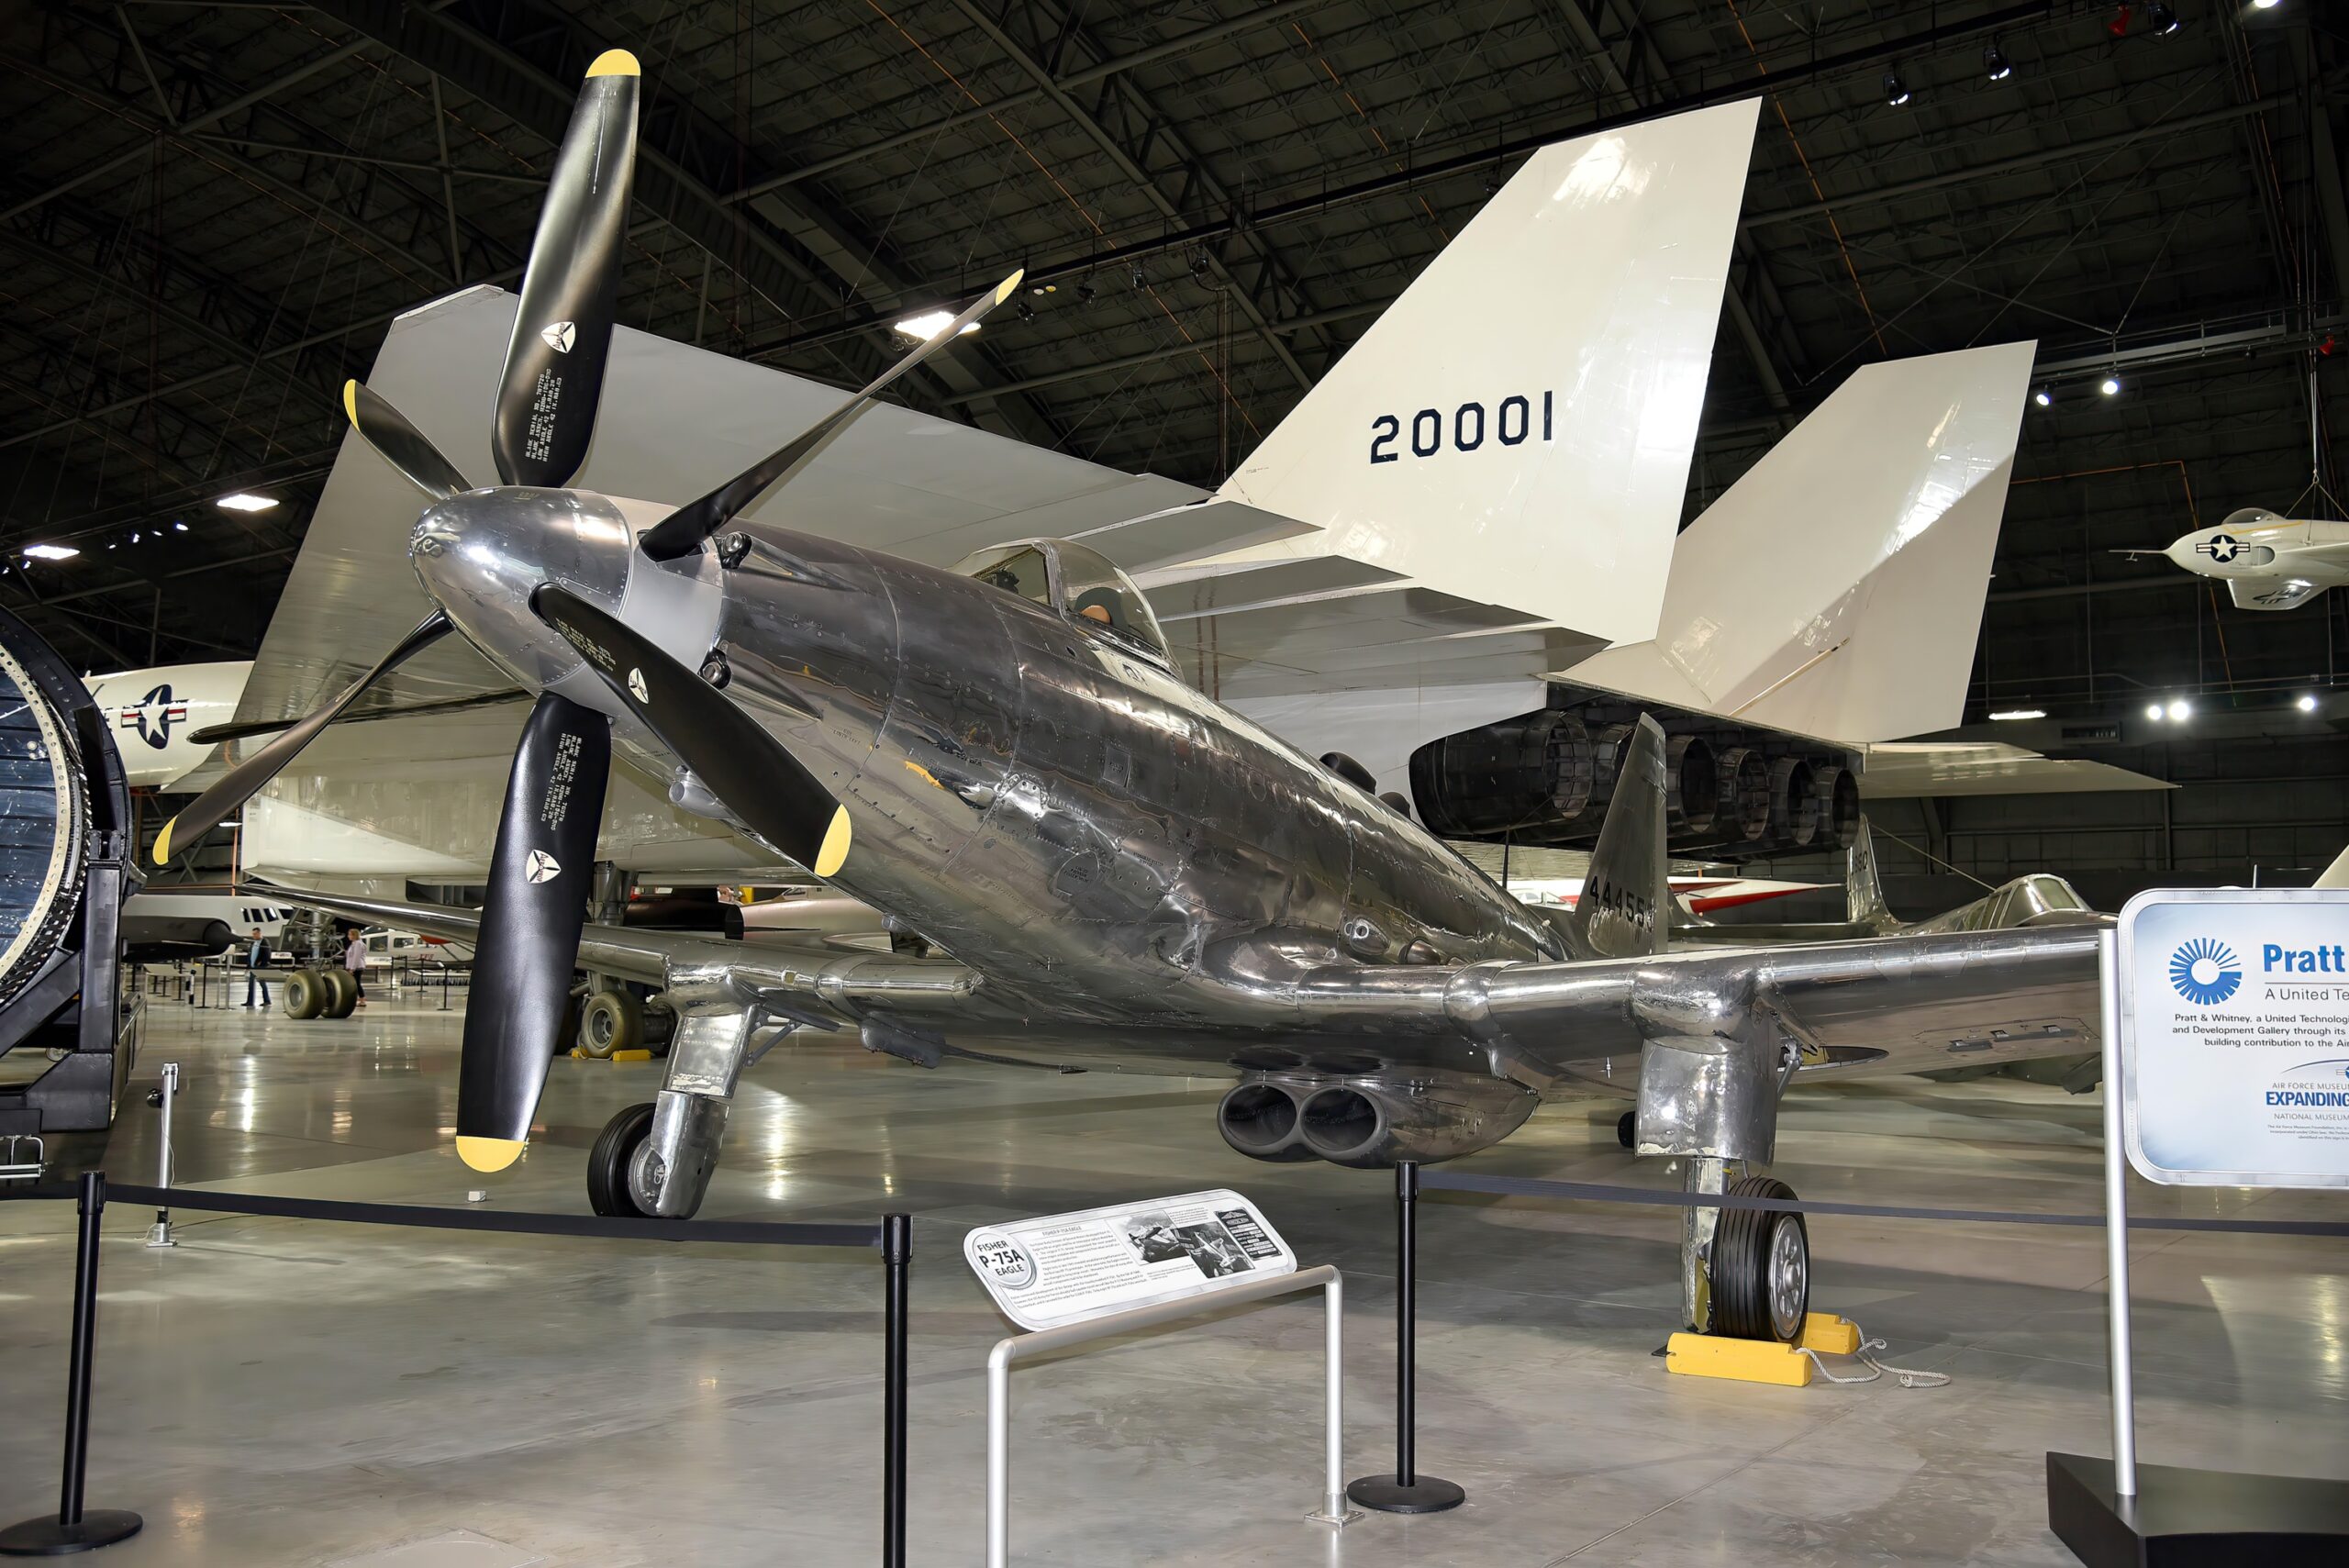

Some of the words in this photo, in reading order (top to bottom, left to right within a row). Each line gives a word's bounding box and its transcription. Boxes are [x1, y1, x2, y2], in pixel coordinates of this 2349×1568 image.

[1371, 390, 1553, 464] 20001
[2263, 944, 2345, 973] Pratt
[2265, 988, 2276, 1000] A
[2280, 988, 2329, 1000] United
[2175, 1014, 2198, 1022] Pratt
[2200, 1014, 2208, 1022] &
[2265, 1015, 2296, 1023] United
[2172, 1026, 2189, 1034] and
[2193, 1026, 2254, 1036] Development
[2257, 1027, 2290, 1036] Gallery
[2294, 1028, 2331, 1037] through
[2204, 1039, 2241, 1048] building
[2244, 1039, 2301, 1047] contribution
[2266, 1092, 2349, 1106] EXPANDING
[976, 1240, 1009, 1252] FISHER
[979, 1249, 1025, 1268] P-75A
[995, 1264, 1025, 1276] EAGLE
